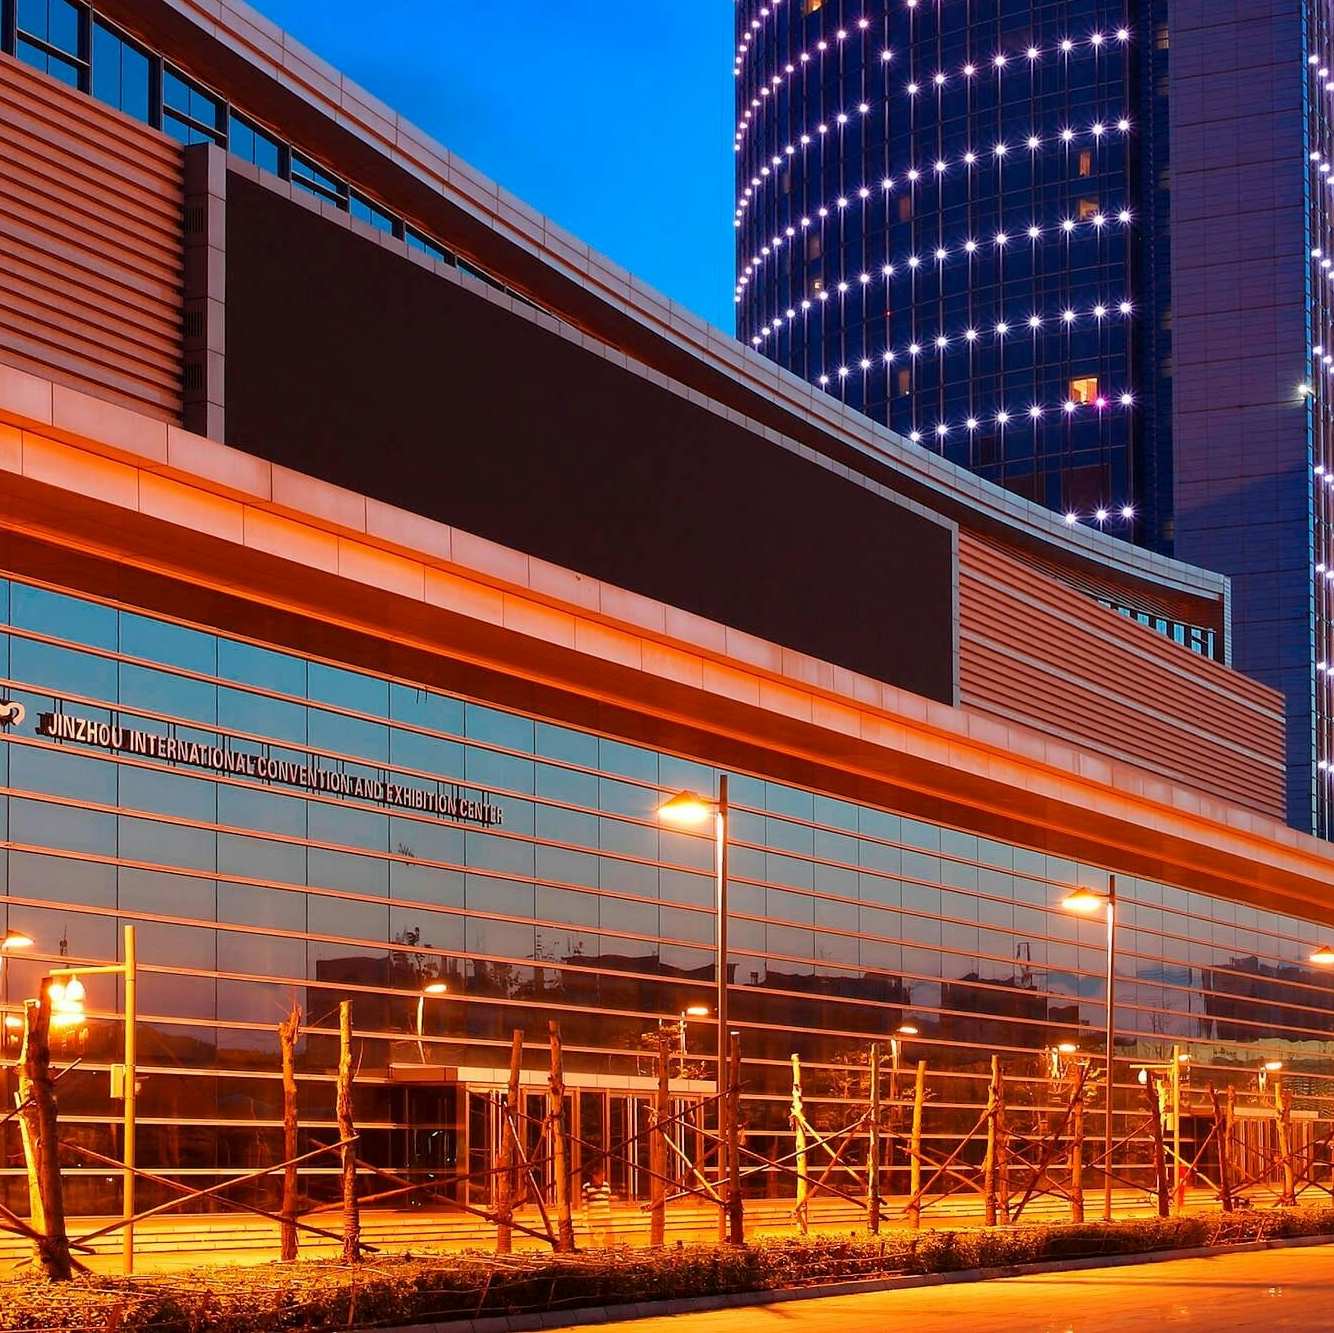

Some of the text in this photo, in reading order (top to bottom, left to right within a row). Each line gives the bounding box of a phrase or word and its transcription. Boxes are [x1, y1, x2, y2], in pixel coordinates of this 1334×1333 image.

[47, 713, 504, 824] JINZHOU INTERNATIONAL CONVENTION AND EXHIBITION CENTER
